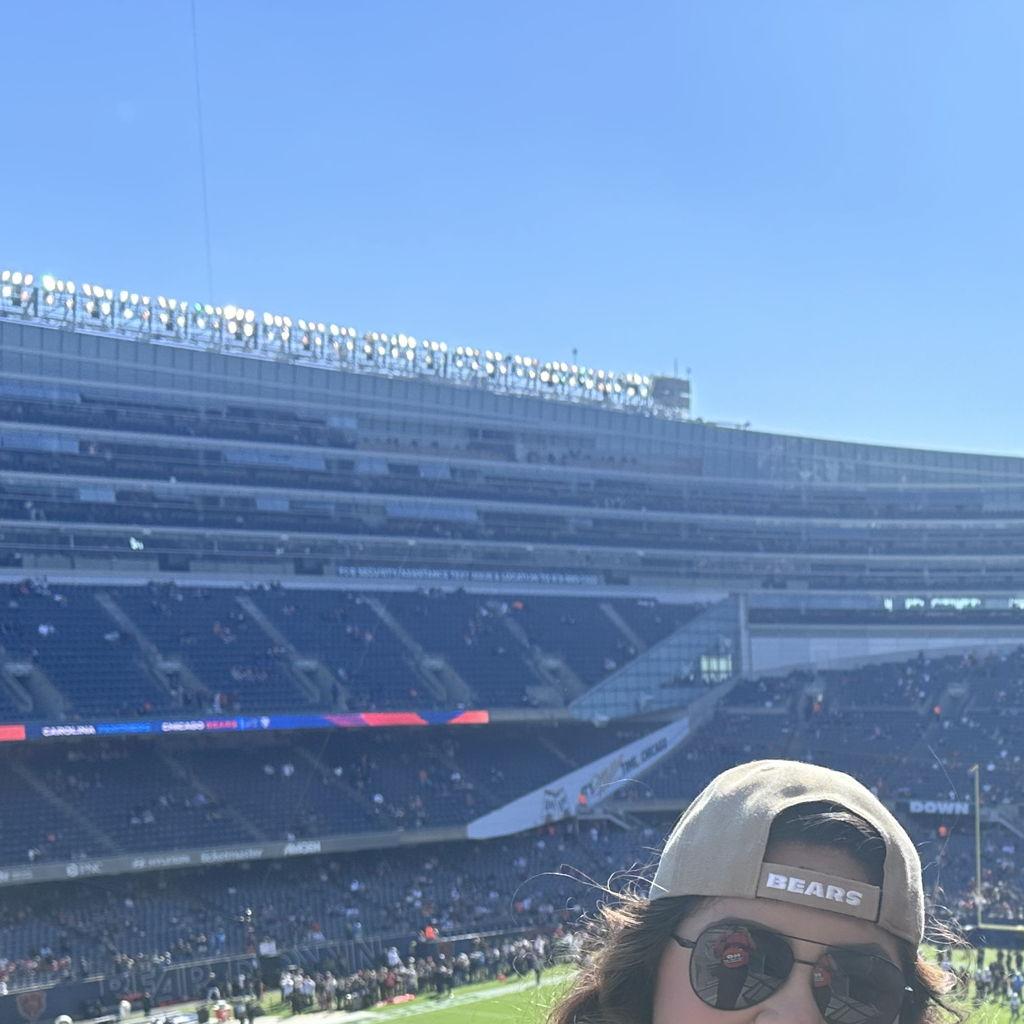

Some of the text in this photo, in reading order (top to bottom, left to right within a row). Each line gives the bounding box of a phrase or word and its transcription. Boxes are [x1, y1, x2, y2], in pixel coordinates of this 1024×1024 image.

[42, 725, 97, 737] CAROLINA
[909, 801, 970, 815] DOWN
[766, 872, 864, 906] BEARS
